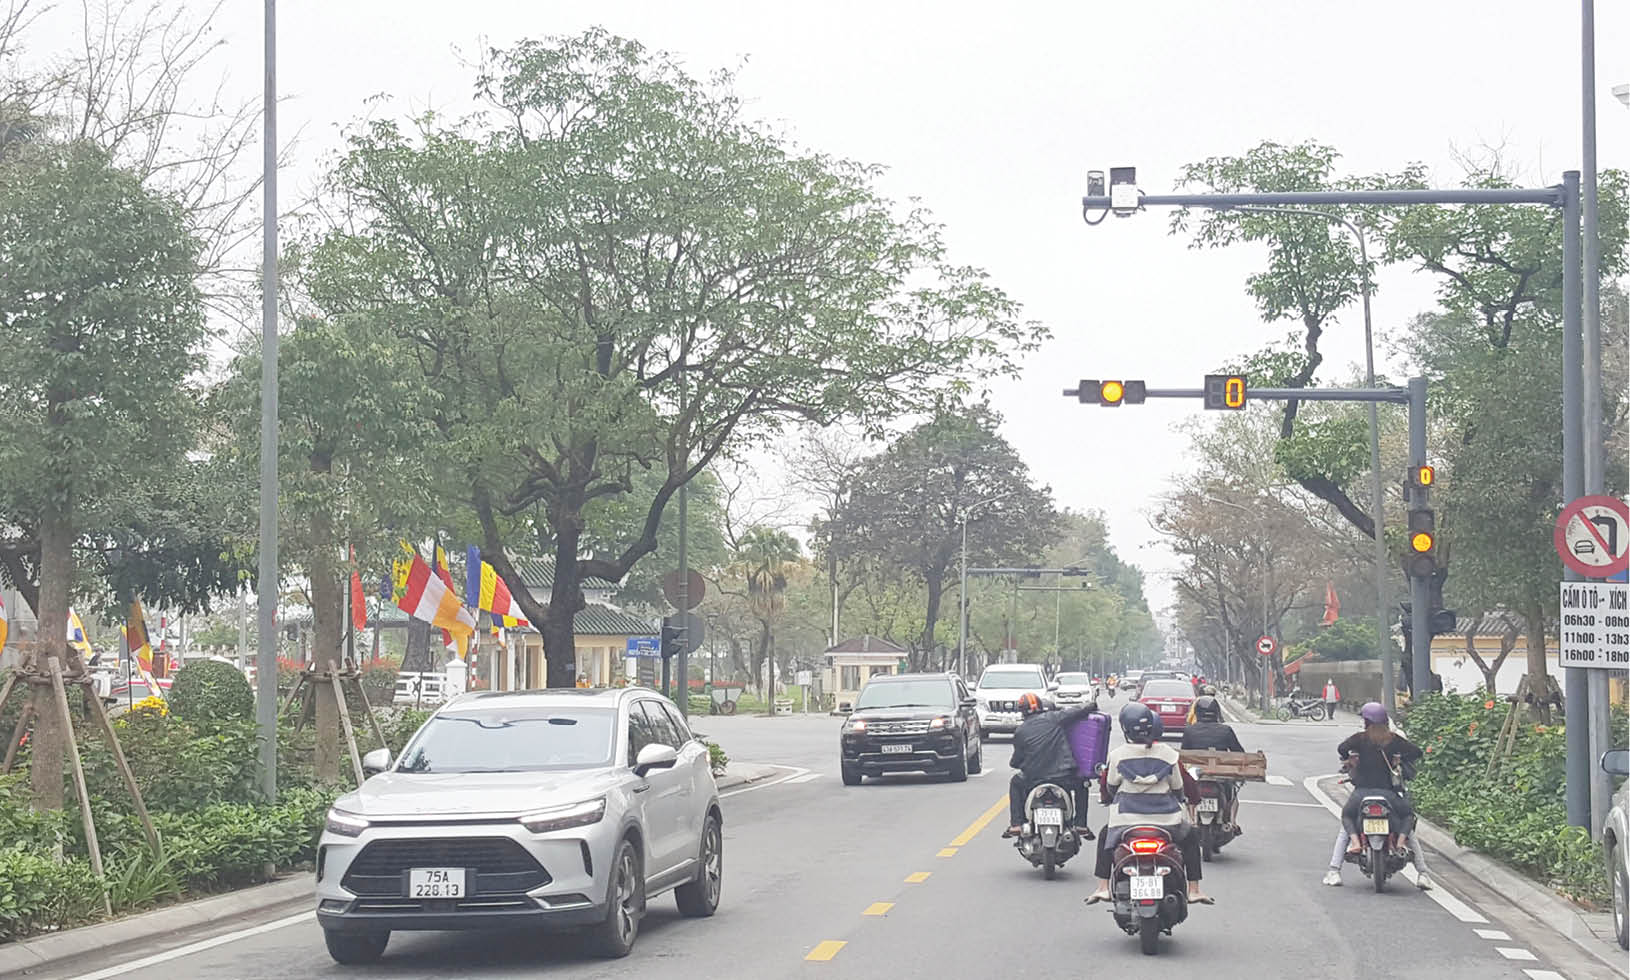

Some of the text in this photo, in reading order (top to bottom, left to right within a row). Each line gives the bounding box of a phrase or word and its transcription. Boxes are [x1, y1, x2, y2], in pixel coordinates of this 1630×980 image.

[1226, 378, 1244, 408] 0
[1420, 467, 1432, 485] 0
[1609, 586, 1627, 610] XÍCH
[1564, 614, 1595, 626] 06h30
[1564, 632, 1595, 644] 11h00
[1564, 649, 1595, 661] 16h00
[426, 870, 450, 883] 75A
[416, 884, 459, 897] 228.13
